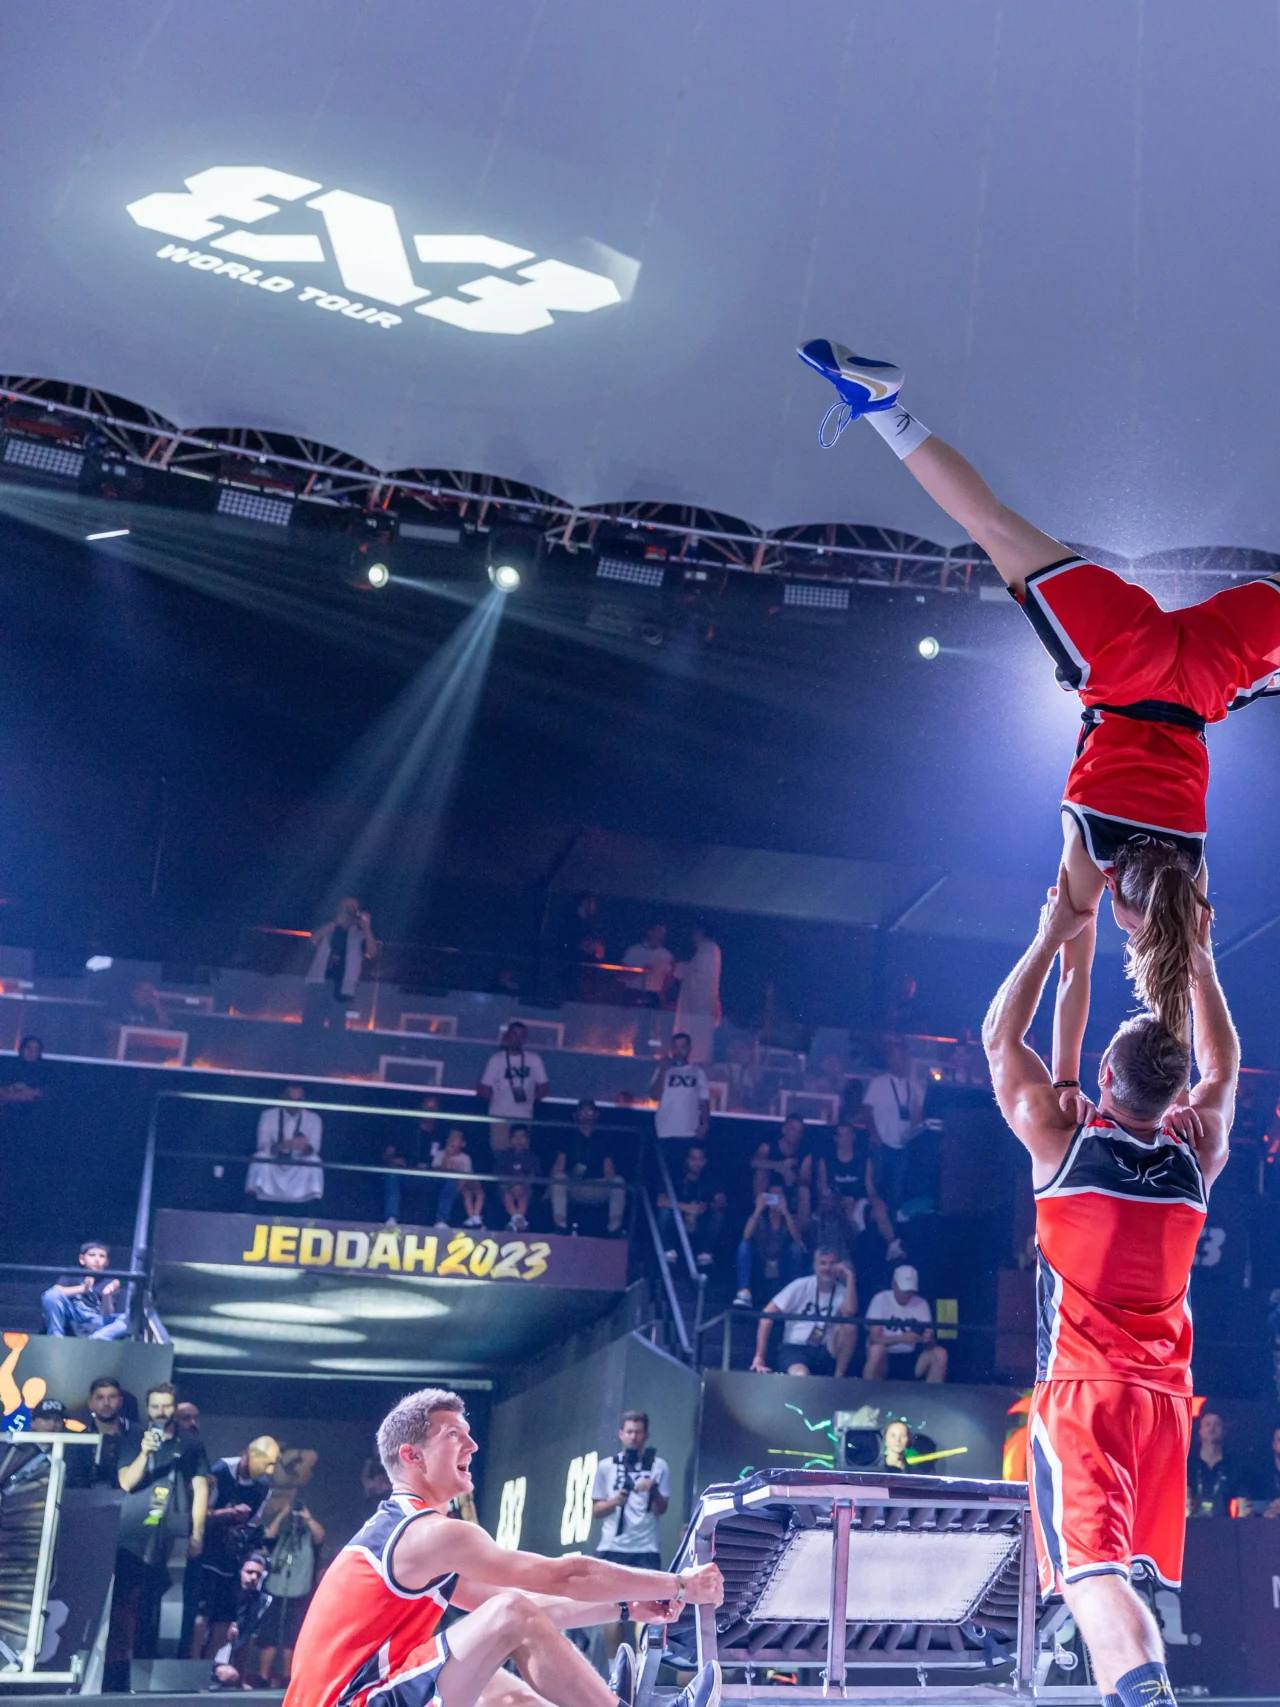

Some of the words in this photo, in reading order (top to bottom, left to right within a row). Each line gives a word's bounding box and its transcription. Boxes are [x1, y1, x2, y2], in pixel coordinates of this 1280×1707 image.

[155, 243, 295, 294] WORLD
[297, 285, 403, 330] TOUR
[243, 1224, 439, 1272] JEDDAH
[437, 1232, 552, 1281] 2023
